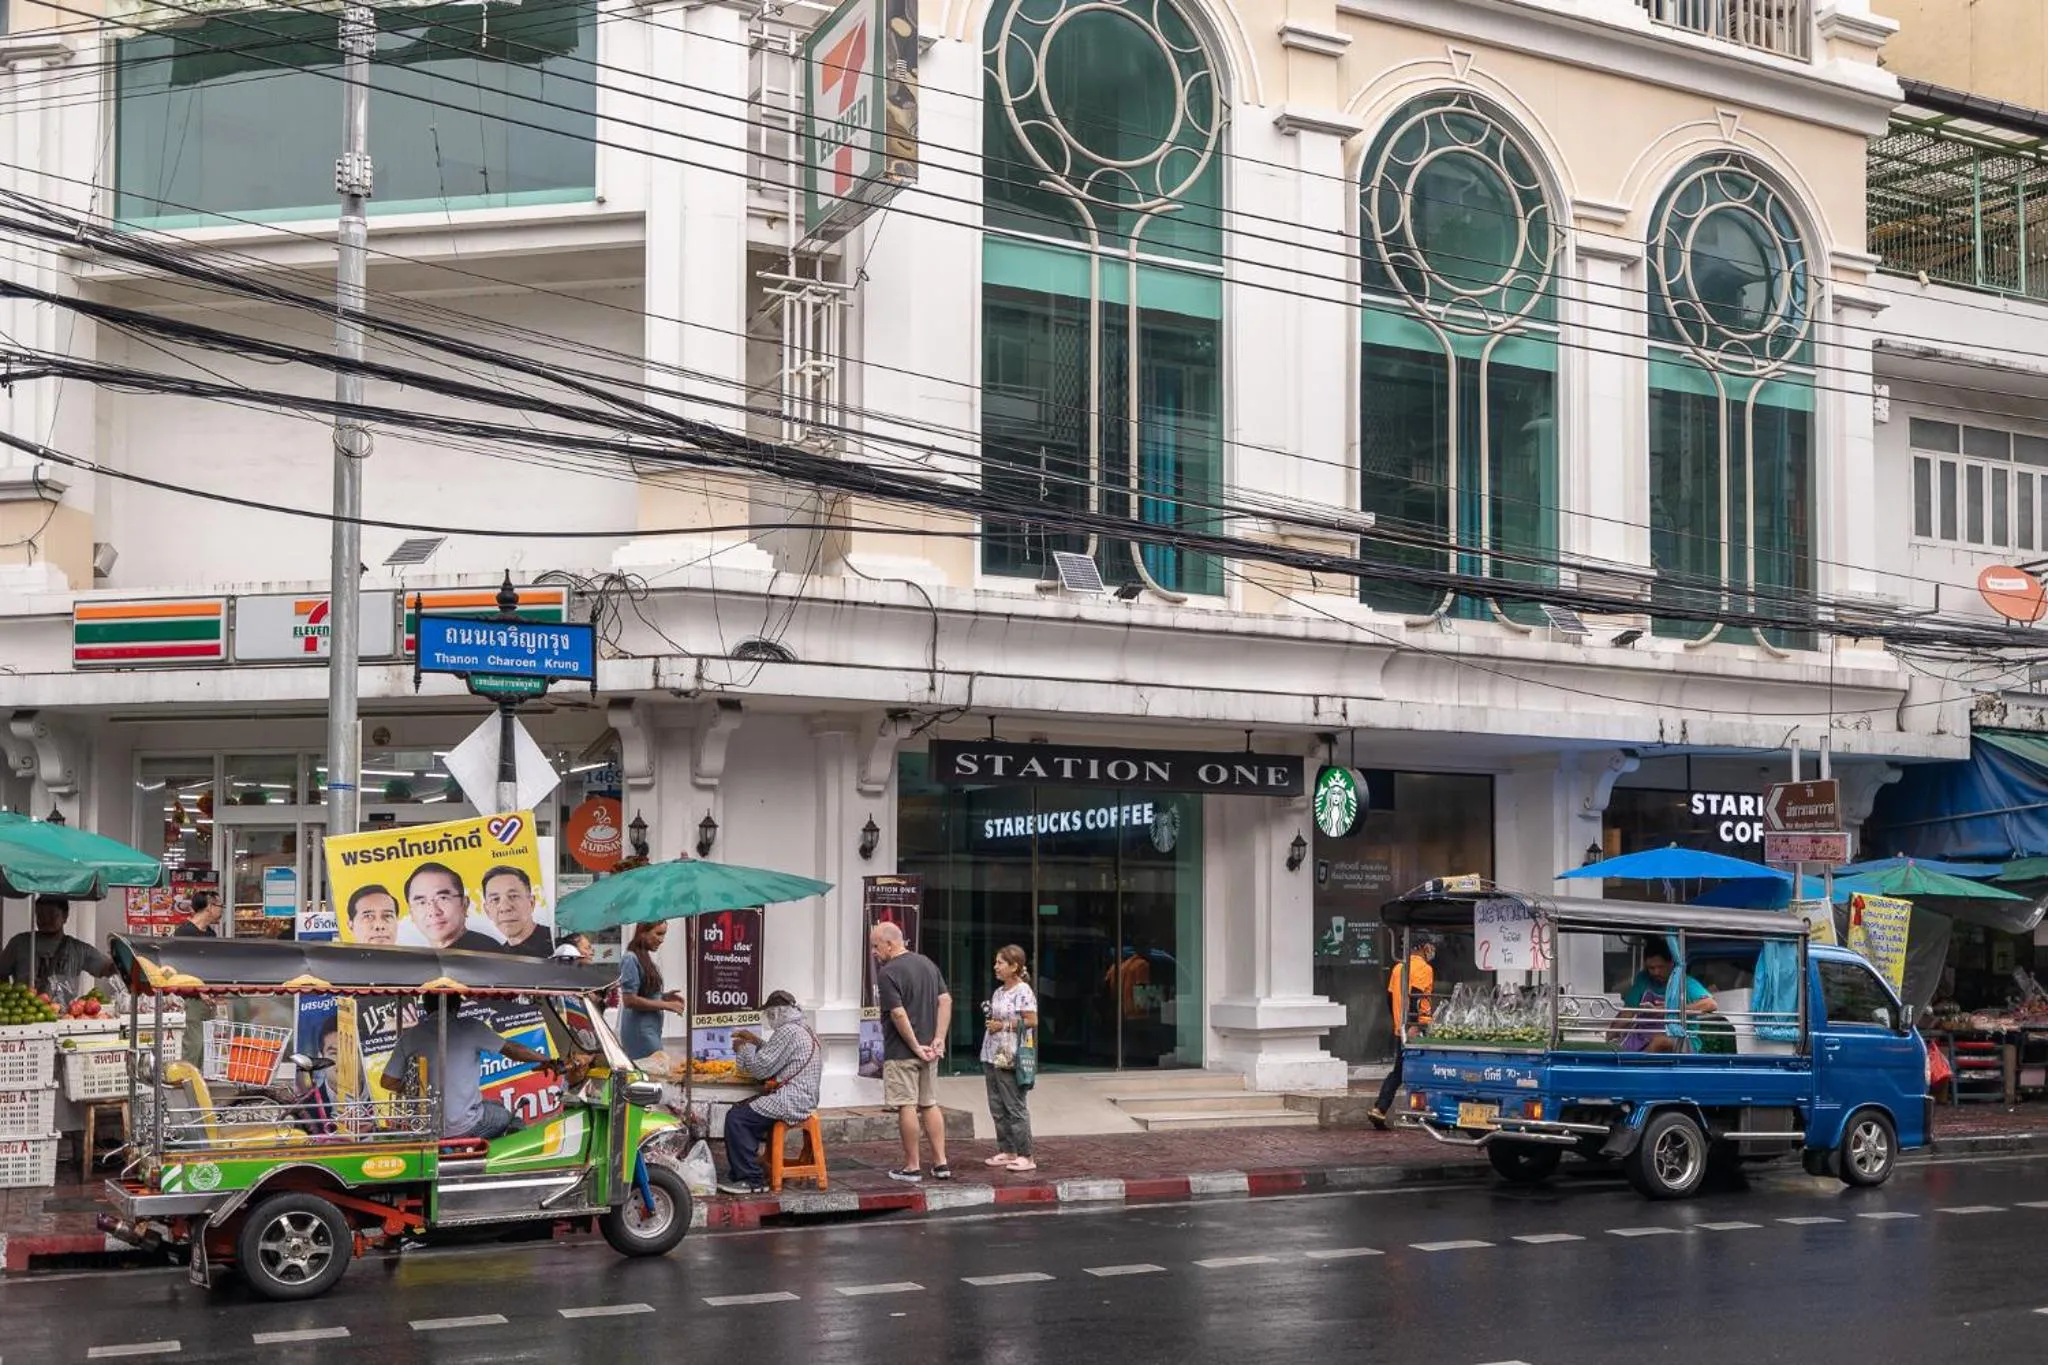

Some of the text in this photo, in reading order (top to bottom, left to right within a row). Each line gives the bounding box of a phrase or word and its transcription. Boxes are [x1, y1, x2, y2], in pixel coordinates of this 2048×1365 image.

[445, 625, 570, 656] ถนนเจริญกรุง
[434, 652, 579, 671] Thanon Charoen Krung
[955, 752, 1290, 787] STATION ONE
[1085, 802, 1154, 831] COFFEE
[340, 827, 482, 866] พรรคไทยภักดี
[705, 990, 748, 1006] 16,000
